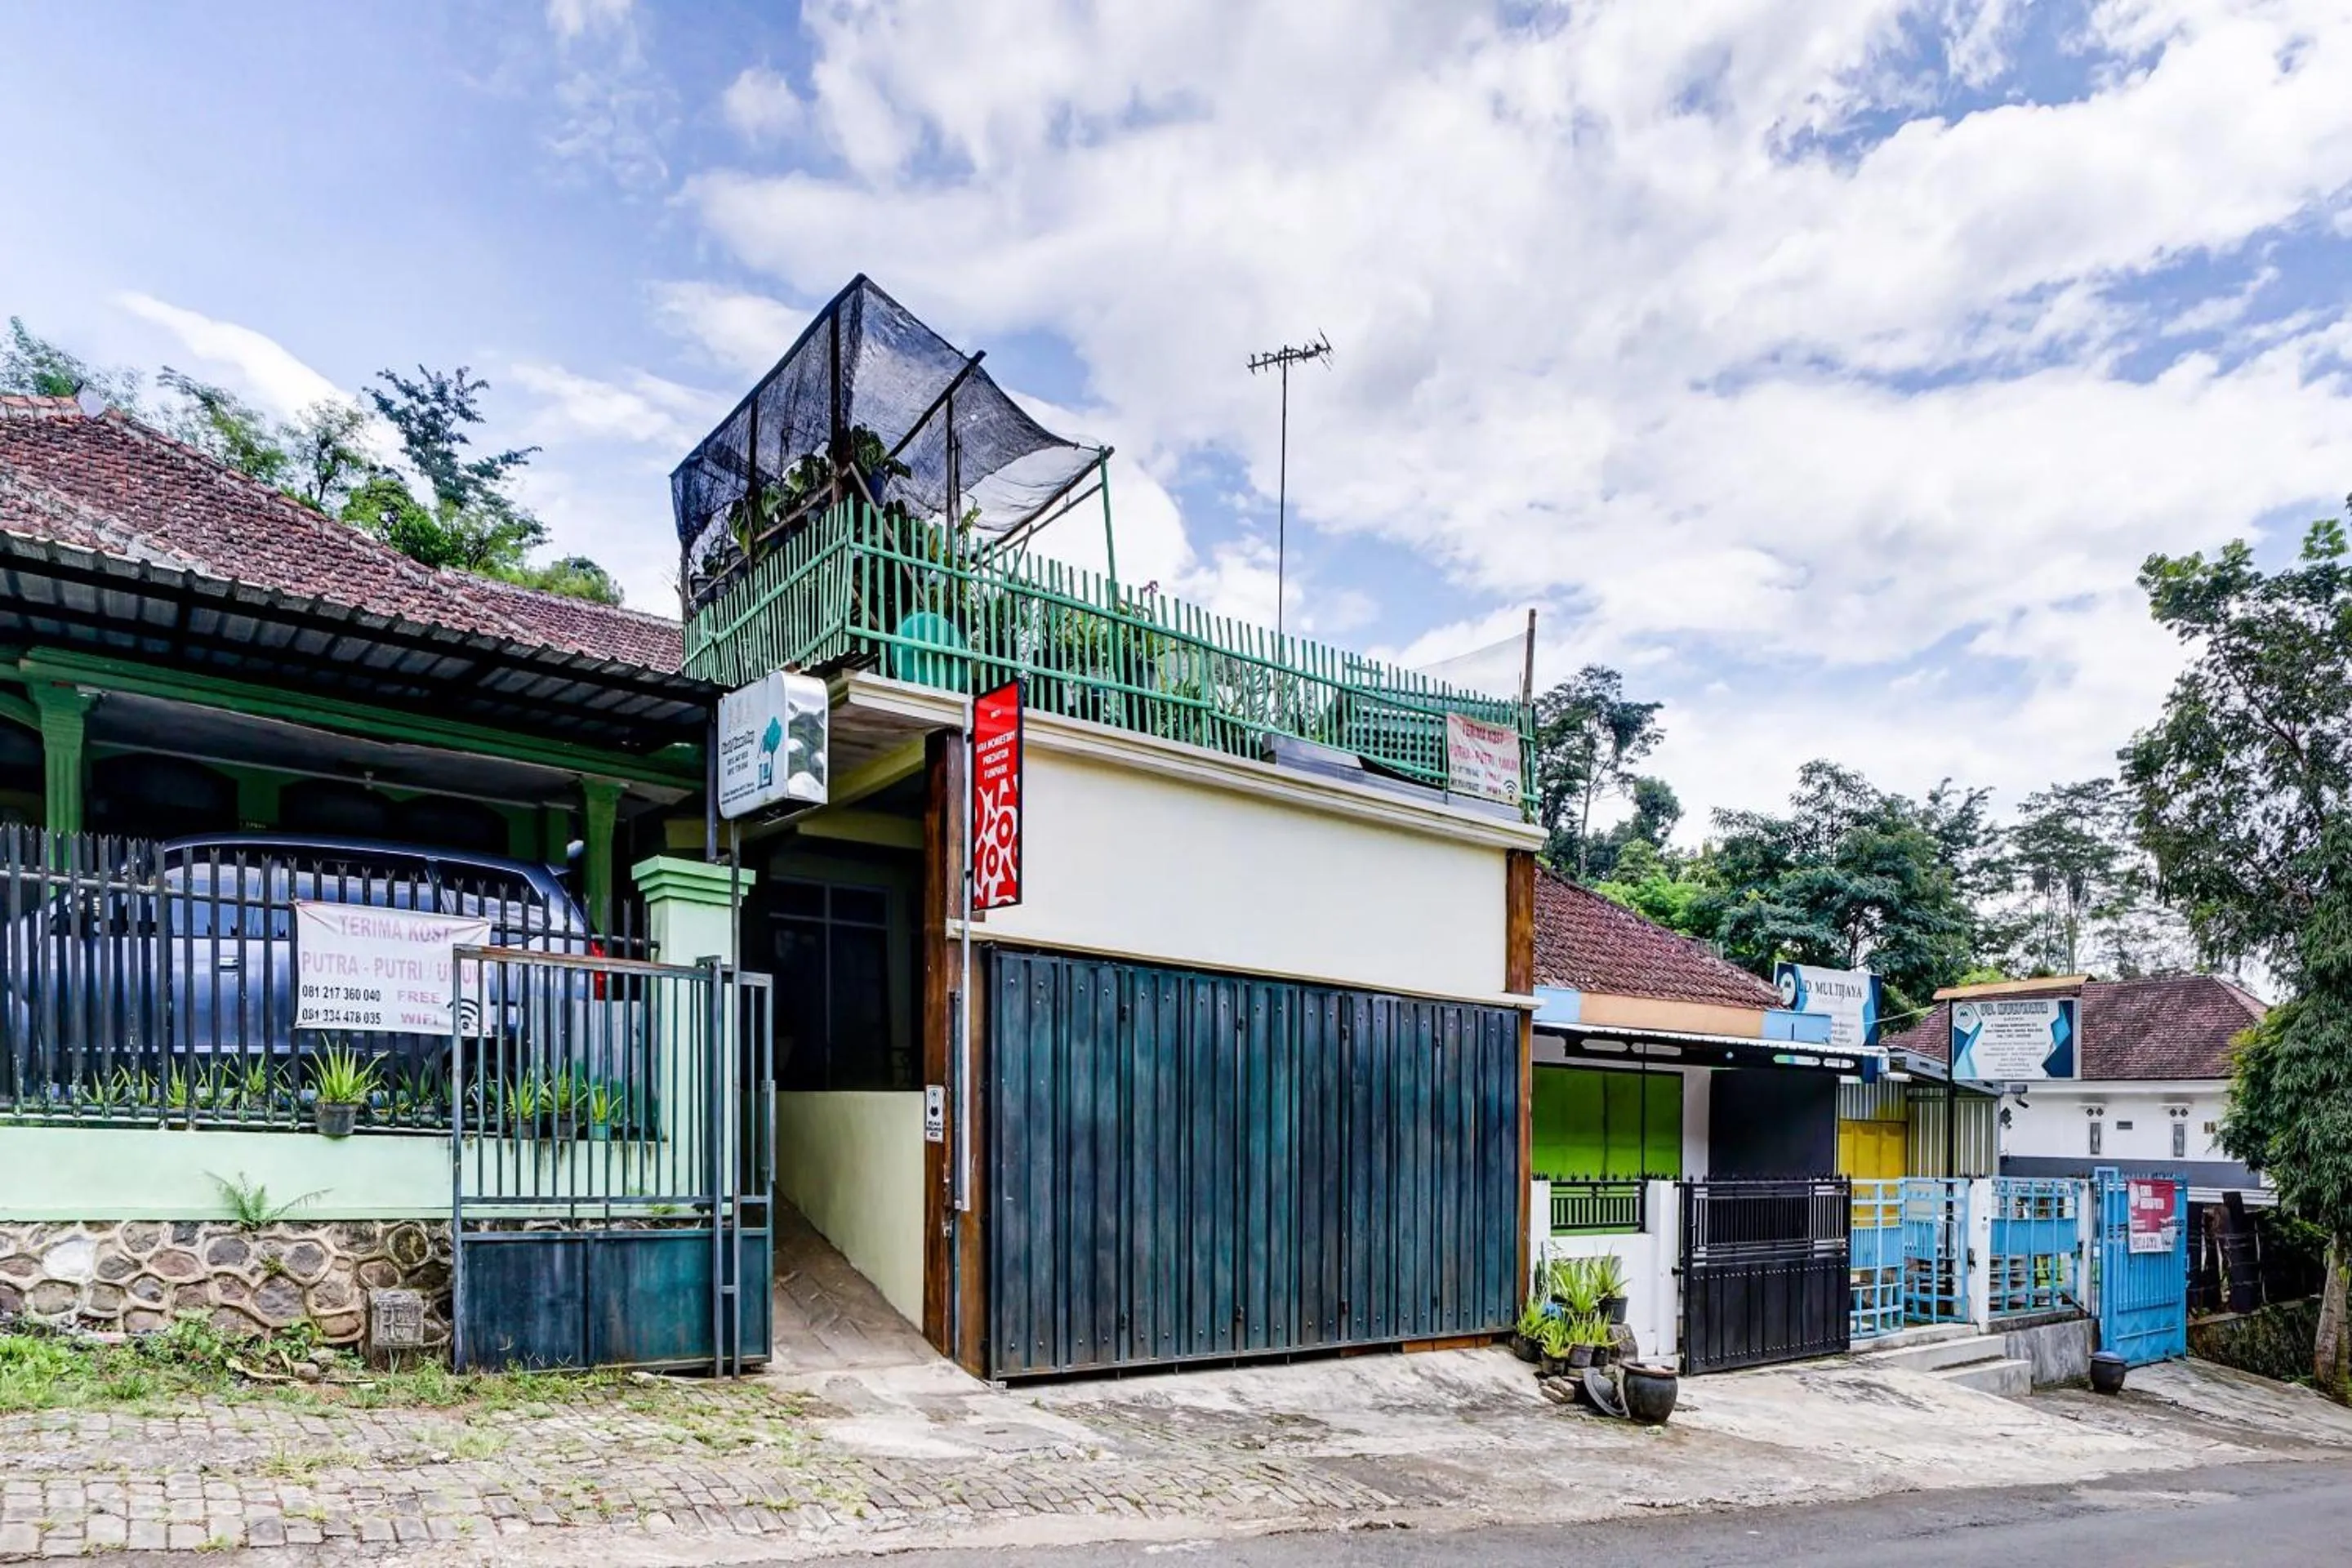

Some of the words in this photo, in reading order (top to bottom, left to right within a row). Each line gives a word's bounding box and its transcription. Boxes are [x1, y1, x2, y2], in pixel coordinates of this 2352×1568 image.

[340, 915, 403, 940] TERIMA
[302, 951, 359, 977] PUTRA
[374, 954, 423, 980] PUTRI
[302, 985, 319, 998] 081
[323, 987, 340, 1000] 217
[343, 987, 361, 1000] 360
[397, 990, 441, 1004] FREE
[1815, 982, 1862, 999] MULTIJAYA
[343, 1010, 361, 1023] 478
[363, 1011, 382, 1024] 035
